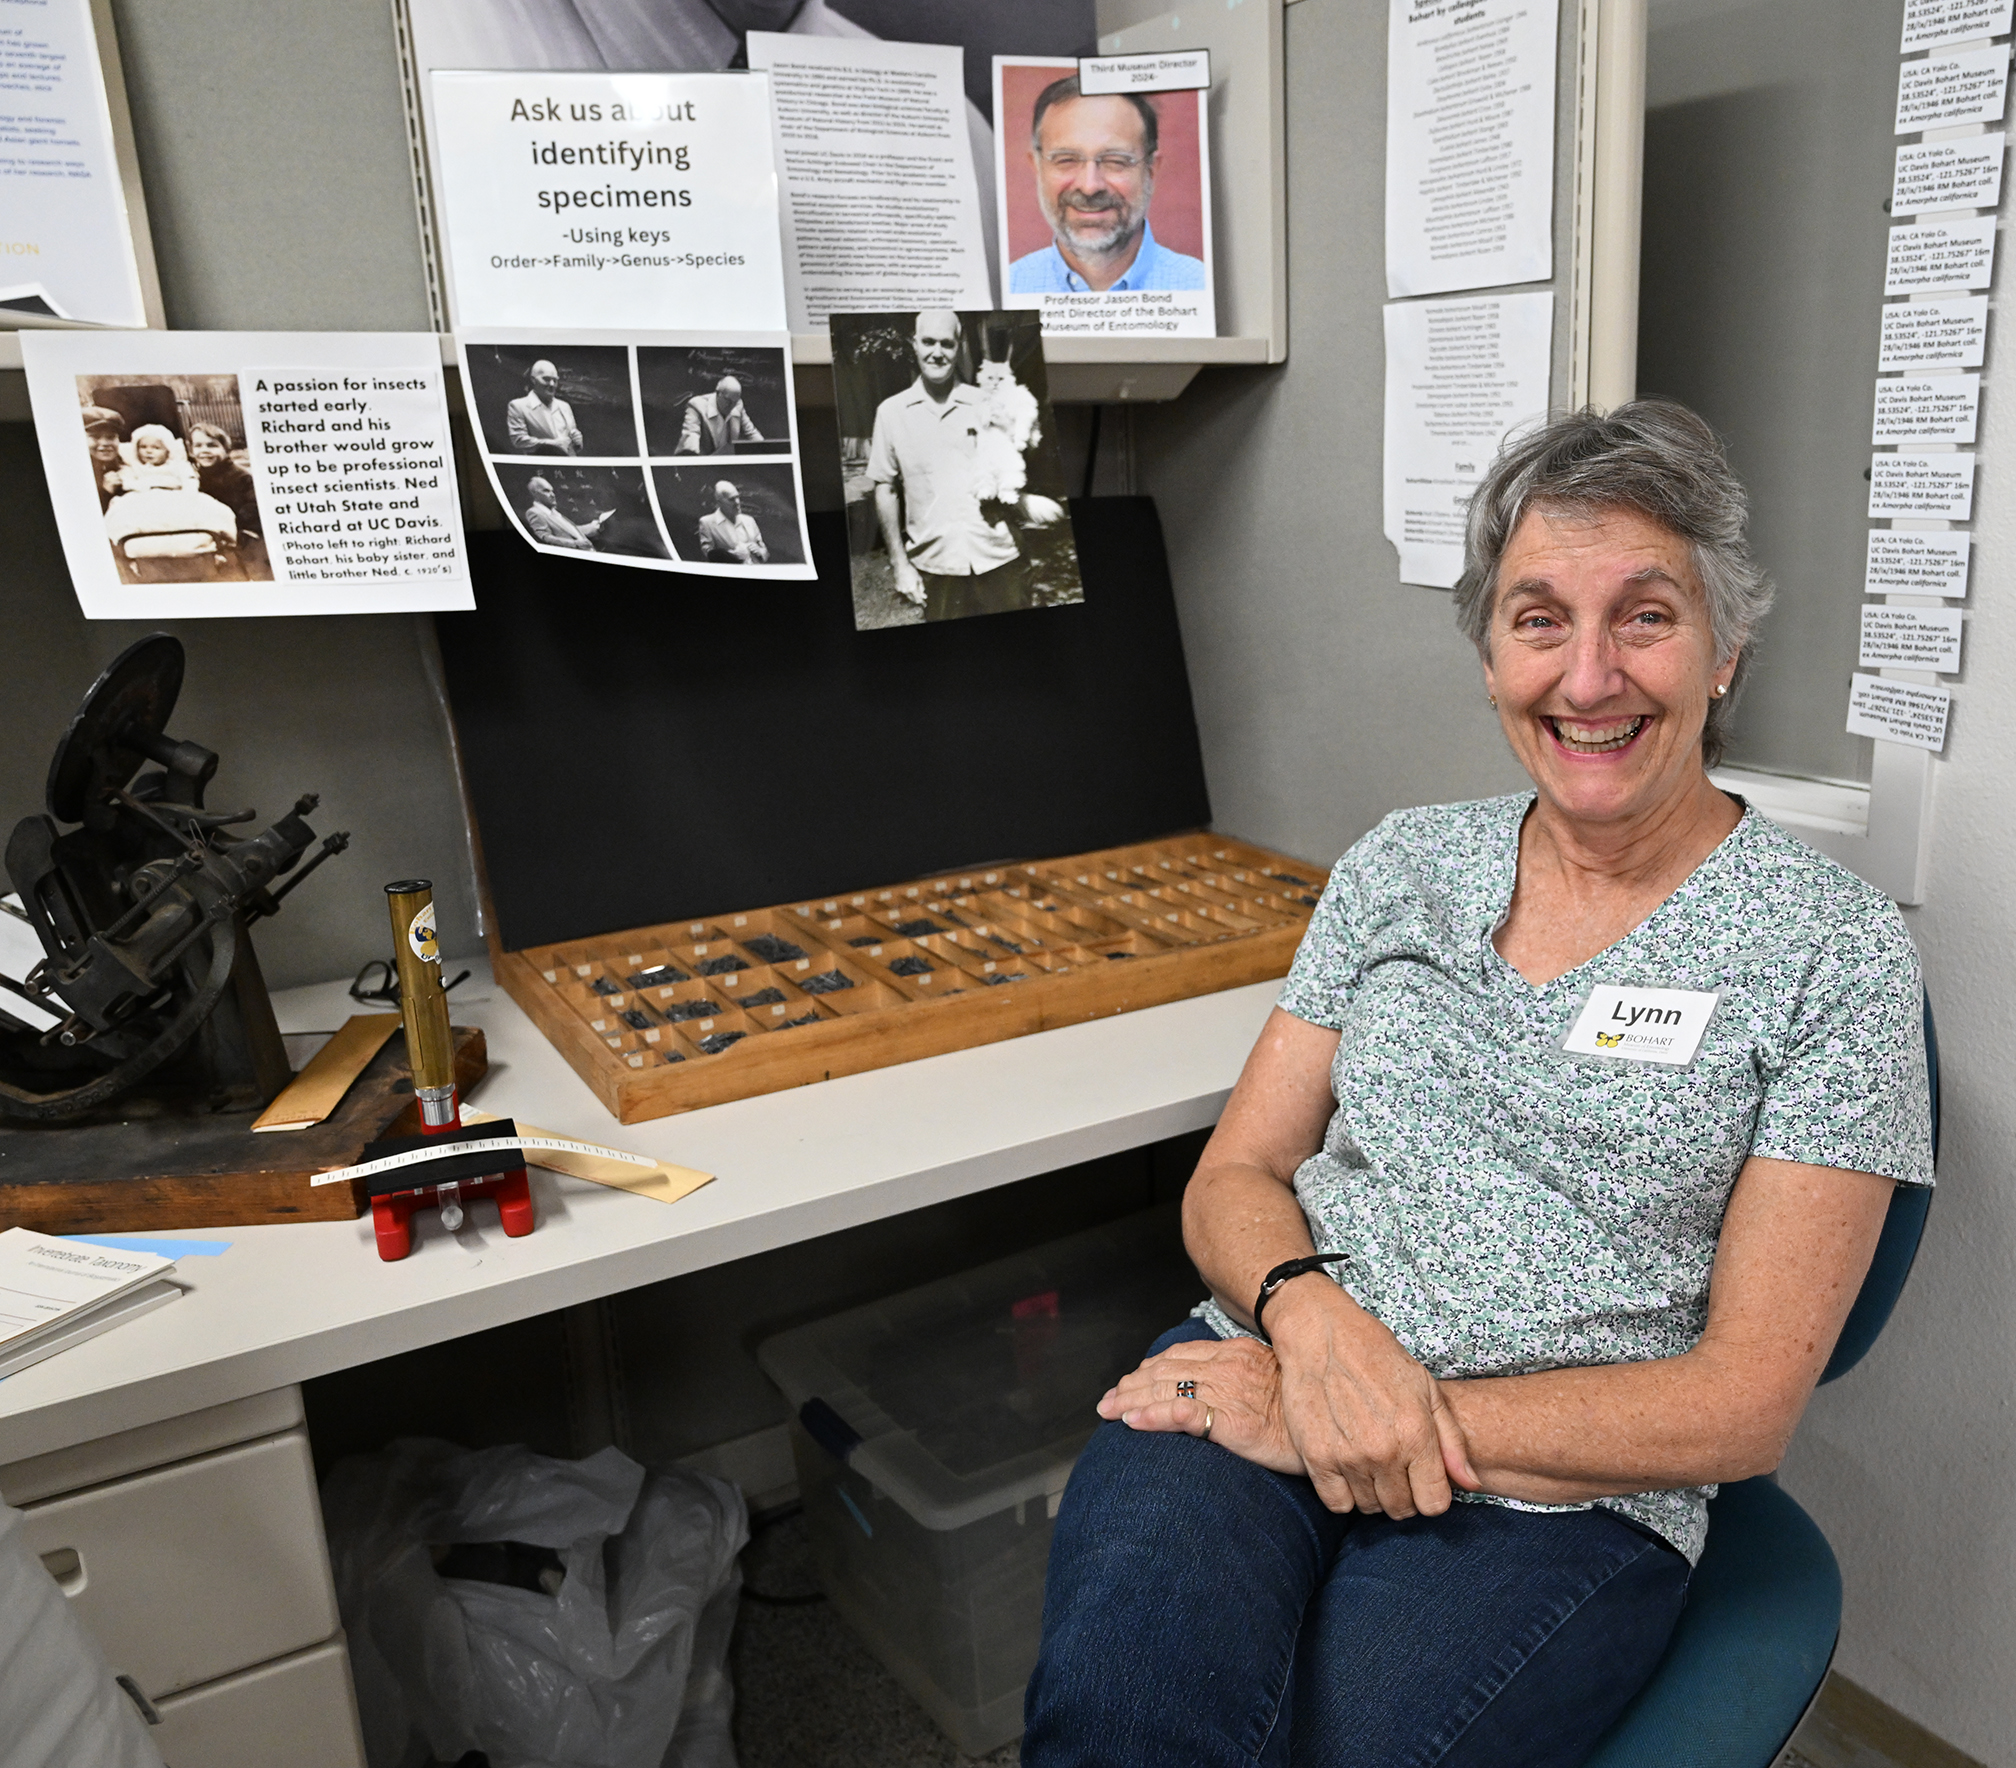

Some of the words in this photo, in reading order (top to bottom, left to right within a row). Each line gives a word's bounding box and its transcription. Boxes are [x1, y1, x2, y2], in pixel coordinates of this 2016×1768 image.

[1118, 63, 1156, 71] Museum
[1159, 60, 1197, 69] Director
[511, 98, 561, 121] Ask
[570, 102, 602, 121] us
[532, 141, 691, 171] identifying
[1931, 160, 1955, 168] Bohart
[1957, 155, 1991, 164] Museum
[1952, 180, 1977, 188] Bohart
[538, 184, 692, 214] specimens
[1905, 196, 1938, 205] Amorpha
[1939, 191, 1979, 201] californica
[563, 228, 623, 247] -Using
[629, 228, 670, 246] keys
[490, 253, 745, 270] Order->Family->Genus->Species
[1045, 295, 1100, 305] Professor
[1104, 295, 1138, 305] Jason
[1142, 294, 1172, 303] Bond
[1040, 309, 1065, 318] rent
[1069, 309, 1117, 318] Director
[1121, 307, 1132, 317] of
[1135, 307, 1154, 316] the
[1159, 307, 1197, 316] Bohart
[1942, 316, 1974, 324] Museum
[1040, 323, 1090, 331] Museum
[1093, 321, 1104, 331] of
[1109, 320, 1179, 331] Entomology
[1892, 353, 1924, 361] Amorpha
[1925, 351, 1963, 359] californica
[254, 379, 268, 391] A
[273, 379, 339, 394] passion
[343, 378, 369, 390] for
[372, 377, 427, 390] insects
[257, 399, 319, 413] started
[323, 398, 373, 414] early.
[261, 419, 326, 433] Richard
[330, 418, 363, 431] and
[368, 417, 392, 431] his
[263, 440, 329, 453] brother
[333, 438, 386, 451] would
[391, 440, 435, 453] grow
[267, 465, 290, 477] up
[294, 463, 311, 473] to
[316, 460, 338, 472] be
[342, 456, 444, 475] professional
[270, 481, 319, 494] insect
[323, 478, 400, 493] scientists.
[404, 475, 439, 489] Ned
[274, 504, 292, 515] at
[296, 500, 337, 513] Utah
[342, 499, 384, 511] State
[388, 496, 420, 509] and
[1881, 502, 1913, 510] Amorpha
[1914, 503, 1951, 512] californica
[278, 520, 342, 534] Richard
[346, 521, 363, 532] at
[367, 518, 391, 530] UC
[395, 515, 443, 528] Davis.
[282, 541, 325, 552] (Photo
[327, 539, 349, 549] left
[352, 539, 365, 548] to
[405, 533, 452, 545] Richard
[336, 554, 354, 563] his
[357, 553, 390, 564] baby
[432, 548, 456, 558] and
[289, 570, 317, 579] little
[321, 568, 368, 578] brother
[1919, 624, 1950, 632] Museum
[1872, 652, 1902, 661] Amorpha
[1904, 654, 1940, 664] californica
[1611, 1000, 1682, 1026] Lynn
[1626, 1034, 1675, 1046] BOHART
[89, 1256, 148, 1274] Taxonomy
